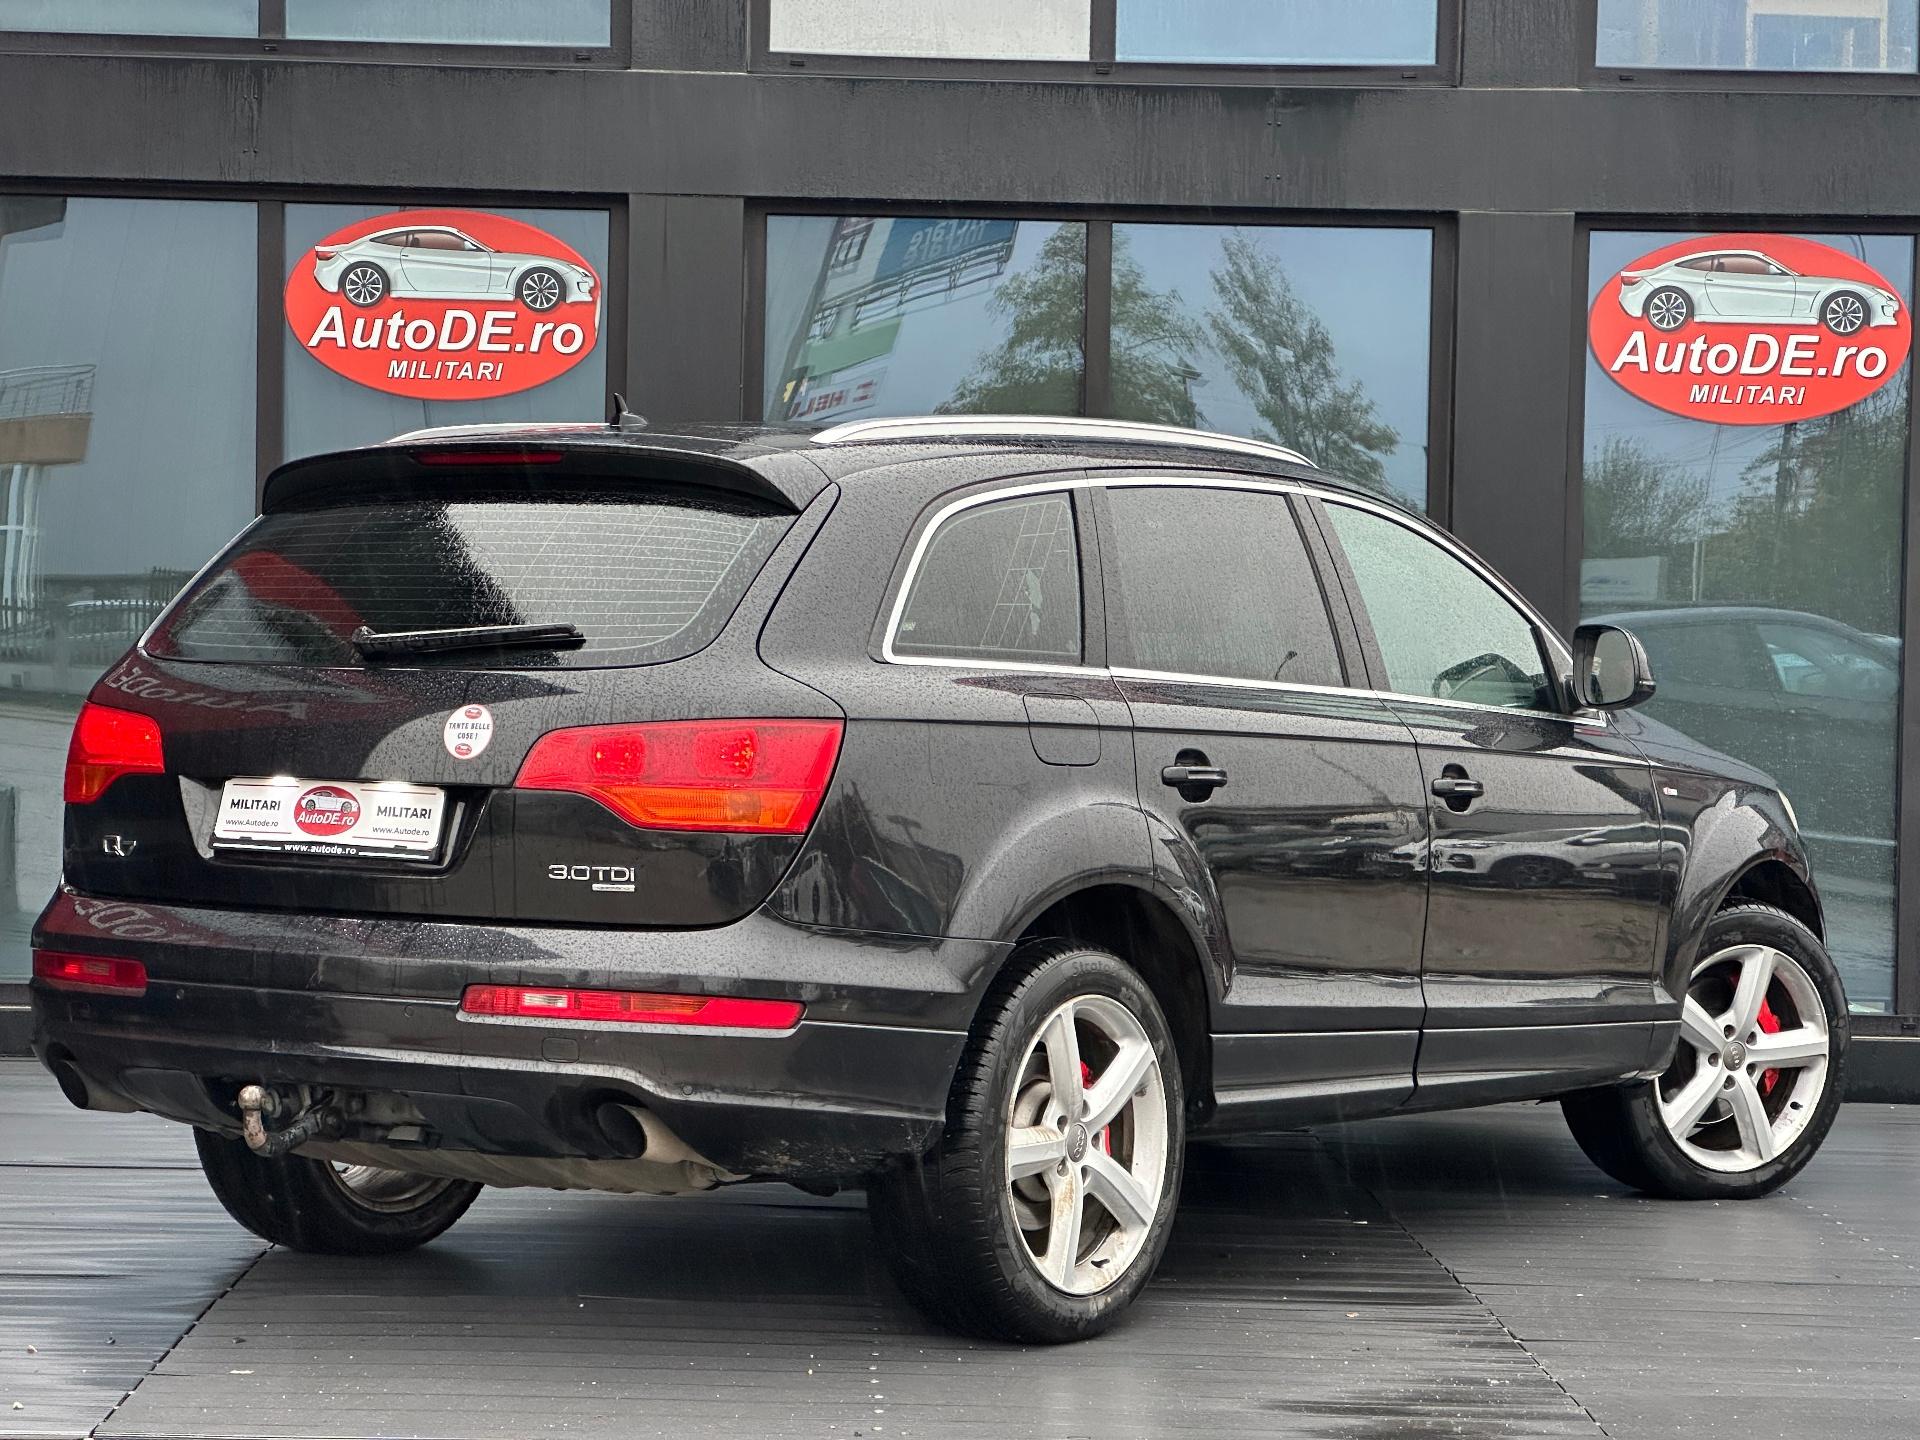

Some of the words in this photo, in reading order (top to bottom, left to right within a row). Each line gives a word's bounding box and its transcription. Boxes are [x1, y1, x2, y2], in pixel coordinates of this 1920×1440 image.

[307, 305, 584, 354] AutoDE.ro
[1611, 330, 1888, 378] AutoDE.ro
[387, 360, 504, 381] MILITARI
[1689, 384, 1806, 405] MILITARI
[449, 722, 469, 730] TANTE
[471, 722, 491, 730] BELLE
[230, 799, 281, 811] MILITARI
[376, 805, 432, 819] MILITARI
[225, 819, 279, 827] www.Autode.ro
[297, 811, 355, 826] AutoDE.ro
[372, 826, 430, 836] www.Autode.ro
[284, 843, 357, 855] www.autode.ro
